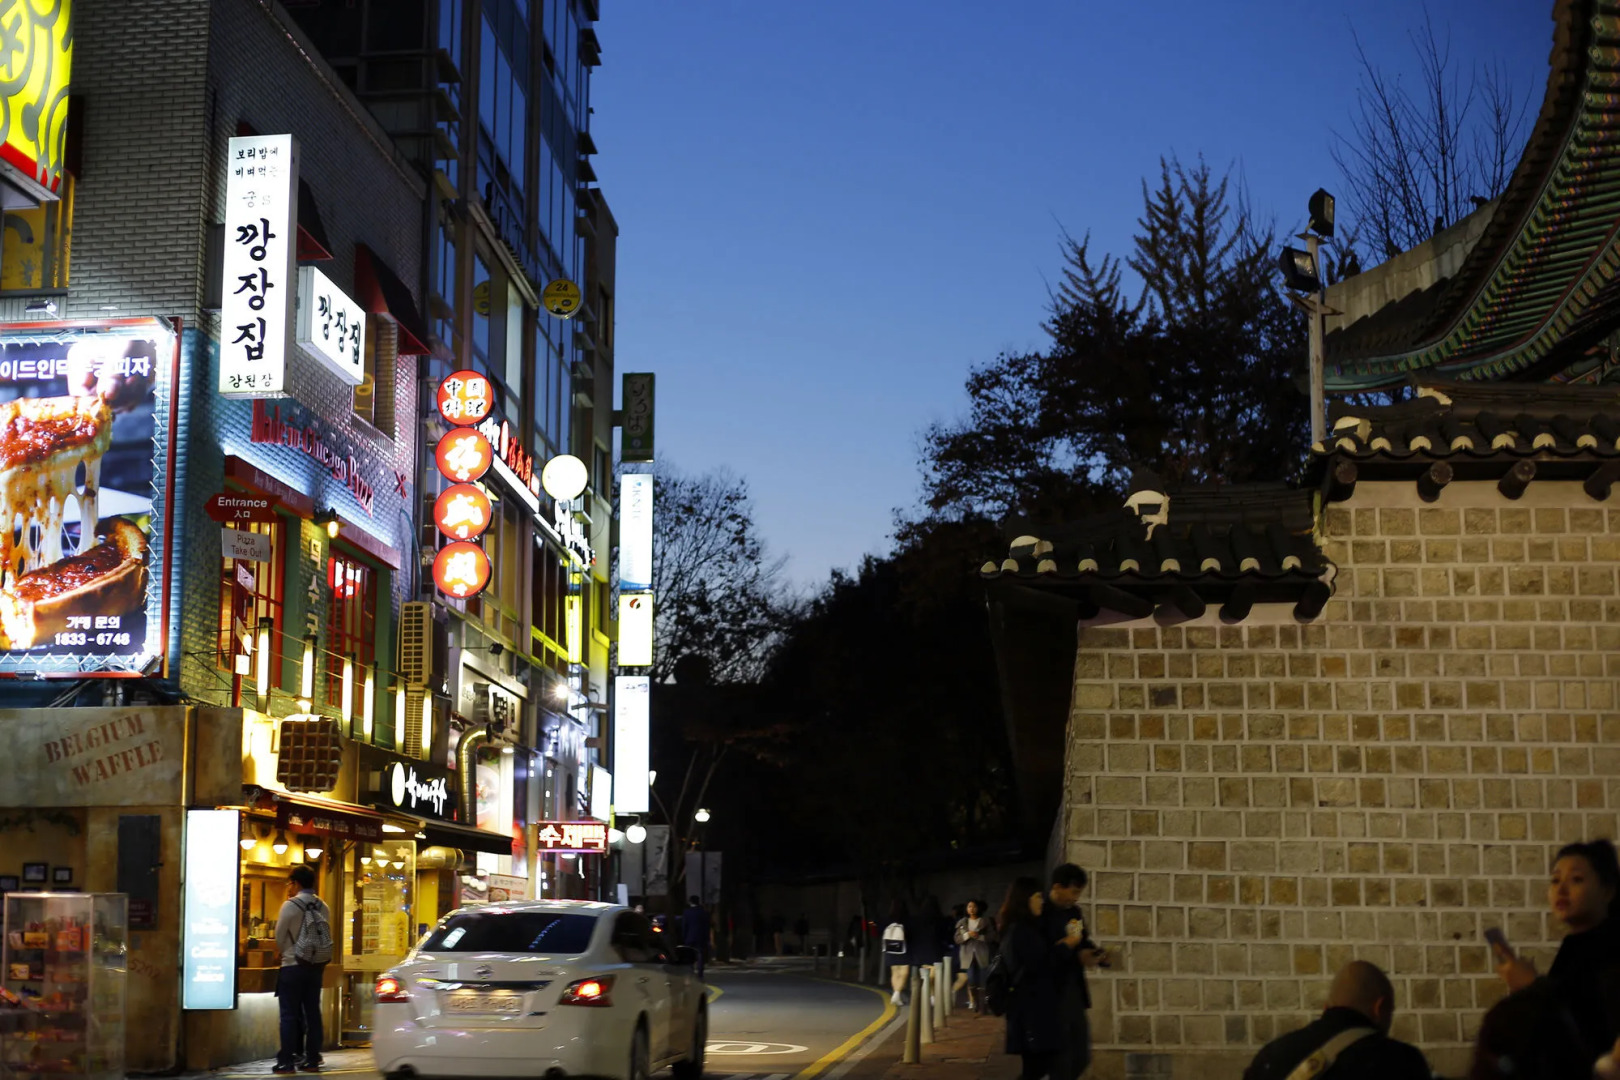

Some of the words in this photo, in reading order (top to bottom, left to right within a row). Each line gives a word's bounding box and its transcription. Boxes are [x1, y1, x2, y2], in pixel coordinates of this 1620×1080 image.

[235, 146, 279, 161] 보리밥에
[231, 217, 276, 361] 깡장집
[318, 294, 361, 365] 깡장집
[228, 372, 273, 389] 강된장
[250, 398, 288, 445] Made
[287, 416, 300, 449] in
[302, 426, 347, 481] Chicago
[347, 454, 374, 518] Pizza
[217, 496, 268, 509] Entrance
[233, 509, 251, 519] 入口
[236, 533, 256, 546] Pizza
[230, 544, 248, 556] Take
[249, 547, 263, 559] Out
[65, 615, 92, 630] 가맹
[94, 615, 121, 630] 문의
[54, 632, 131, 646] 1833-6748
[45, 712, 146, 764] BELGIUM
[71, 740, 165, 787] WAFFLE
